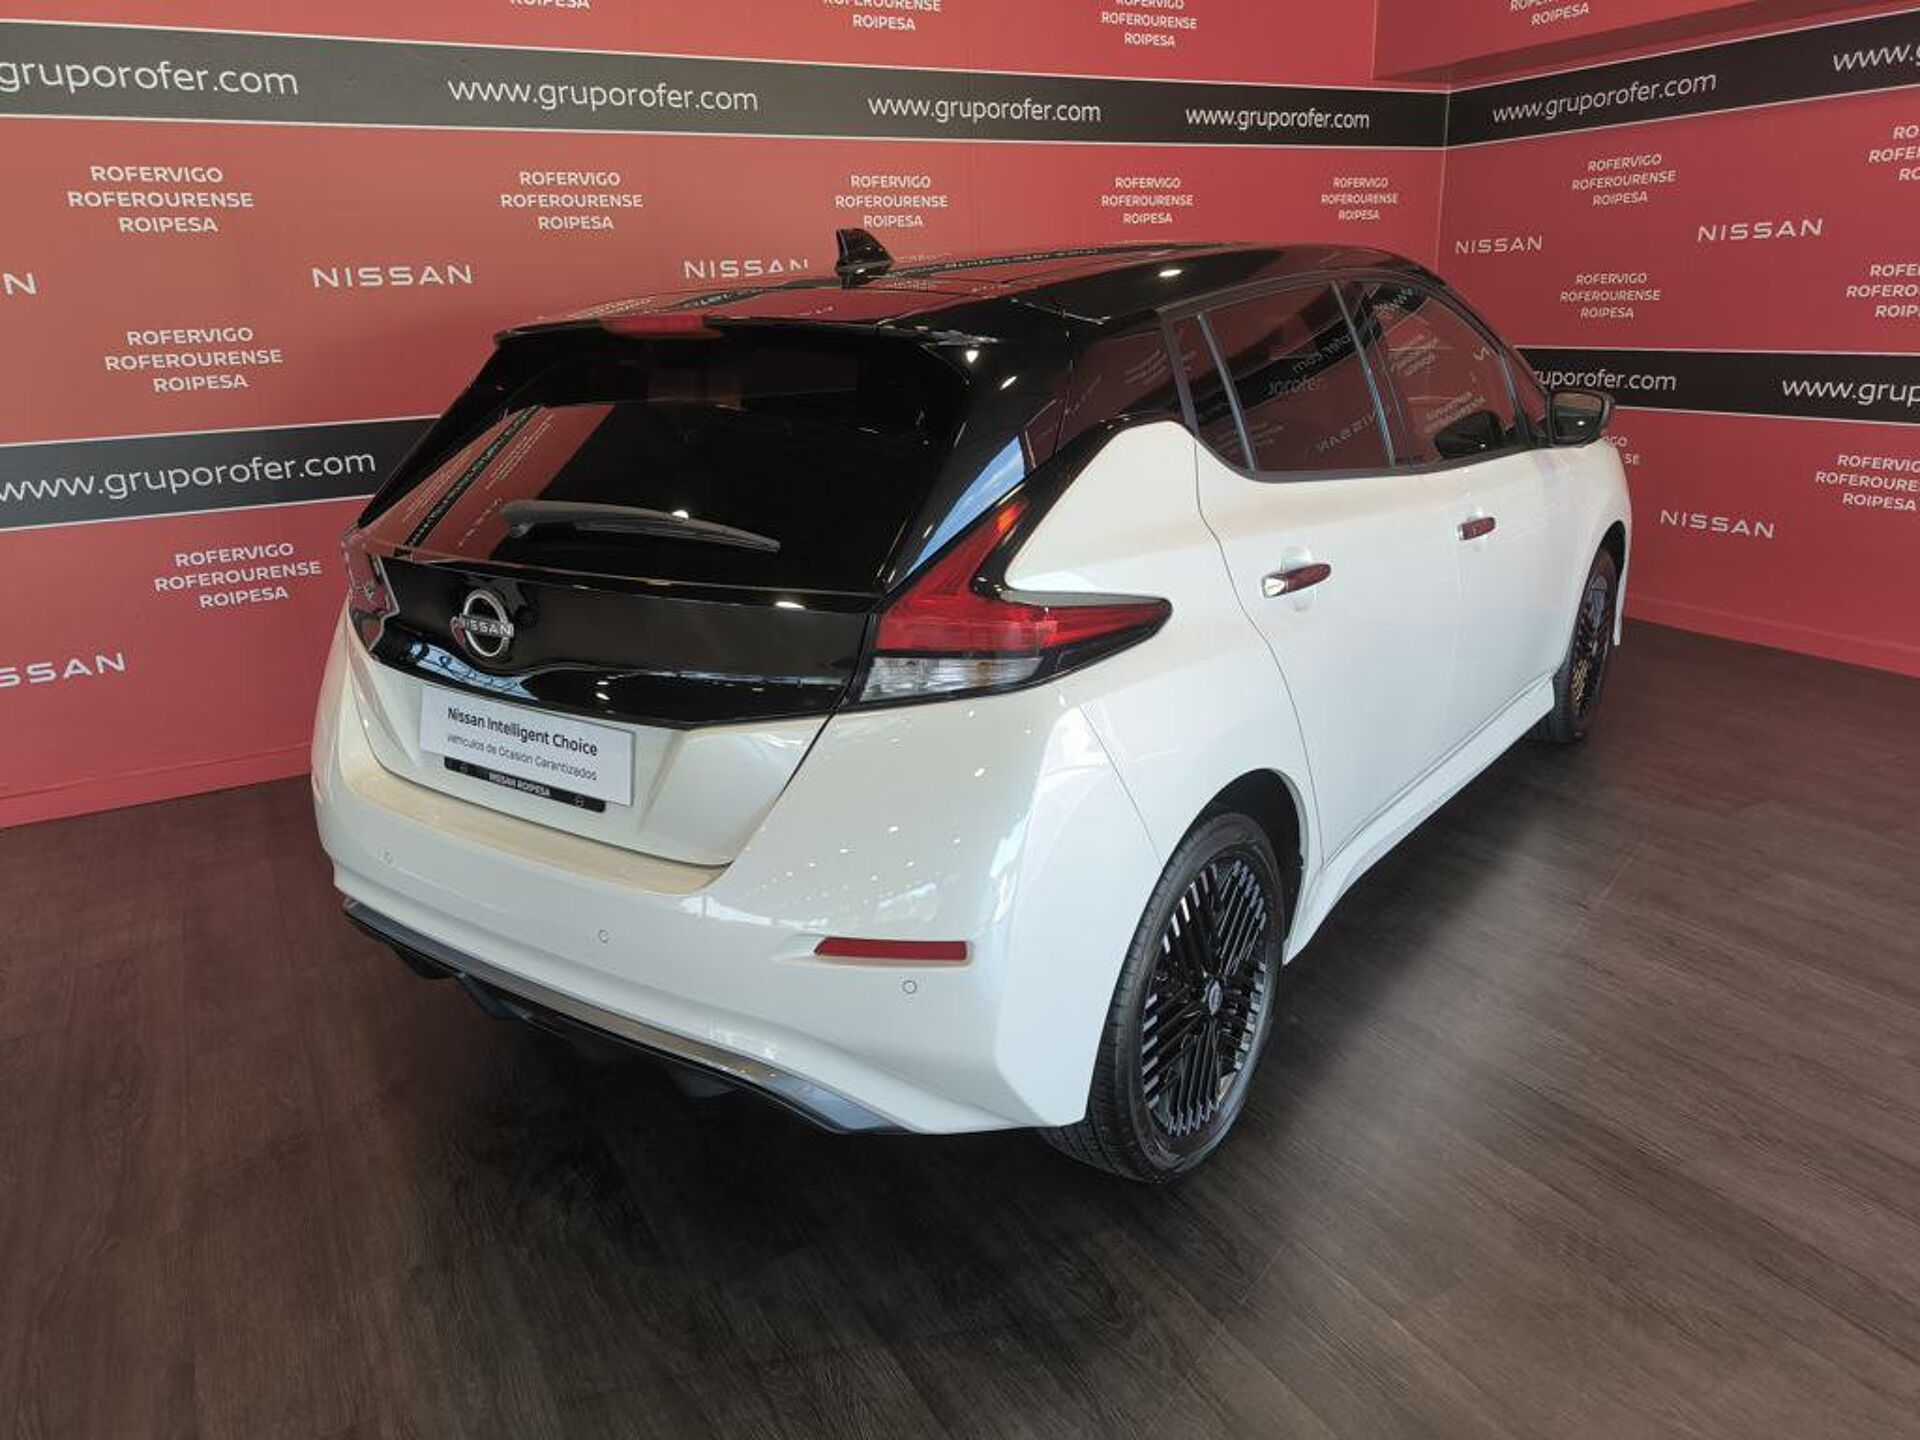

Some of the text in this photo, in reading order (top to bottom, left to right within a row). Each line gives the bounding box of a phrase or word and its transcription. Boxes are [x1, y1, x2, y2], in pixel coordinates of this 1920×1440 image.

[853, 14, 916, 31] ROIPESA
[1102, 11, 1197, 29] ROFEROURENSE
[1531, 3, 1590, 25] ROIPESA
[1124, 31, 1176, 47] ROIPESA
[1833, 44, 1920, 72] www.
[447, 79, 758, 112] www.gruporofer.com
[1493, 73, 1717, 122] www.gruporofer.com
[867, 97, 1101, 124] www.gruporofer.com
[1186, 107, 1370, 131] www.gruporofer.com
[1587, 154, 1662, 172] ROFERVIGO
[1869, 146, 1920, 163] ROFE
[89, 165, 223, 183] ROFERVIGO
[519, 171, 621, 186] ROFERVIGO
[850, 174, 931, 188] ROFERVIGO
[1115, 177, 1181, 189] ROFERVIGO
[1333, 177, 1389, 189] ROFERVIGO
[1572, 170, 1677, 191] ROFEROURENSE
[67, 191, 254, 208] ROFEROURENSE
[500, 194, 644, 208] ROFEROURENSE
[835, 194, 948, 208] ROFEROURENSE
[1101, 194, 1193, 206] ROFEROURENSE
[1321, 193, 1397, 205] ROFEROURENSE
[1592, 190, 1648, 206] ROIPESA
[537, 215, 614, 230] ROIPESA
[863, 214, 923, 228] ROIPESA
[1123, 212, 1173, 225] ROIPESA
[1338, 209, 1381, 221] ROIPESA
[118, 216, 219, 233] ROIPESA
[1697, 218, 1823, 242] NISSAN
[1455, 235, 1542, 254] NISSAN
[312, 264, 472, 288] NISSAN
[683, 258, 809, 279] NISSAN
[1870, 264, 1920, 278] ROFE
[1575, 272, 1648, 286] ROFERVIGO
[1560, 289, 1661, 302] ROFEROURENSE
[1580, 306, 1634, 319] ROIPESA
[1874, 305, 1920, 318] ROIP
[126, 327, 254, 346] ROFERVIGO
[104, 349, 283, 371] ROFEROURENSE
[153, 374, 249, 393] ROIPESA
[0, 450, 376, 501] www.gruporofer.com
[1842, 492, 1918, 511] ROIPESA
[1660, 509, 1775, 539] NISSAN
[175, 542, 294, 568] ROFERVIGO
[154, 561, 323, 592] ROFEROURENSE
[199, 586, 289, 609] ROIPESA
[448, 707, 598, 757] Nissan Intelligent Choice
